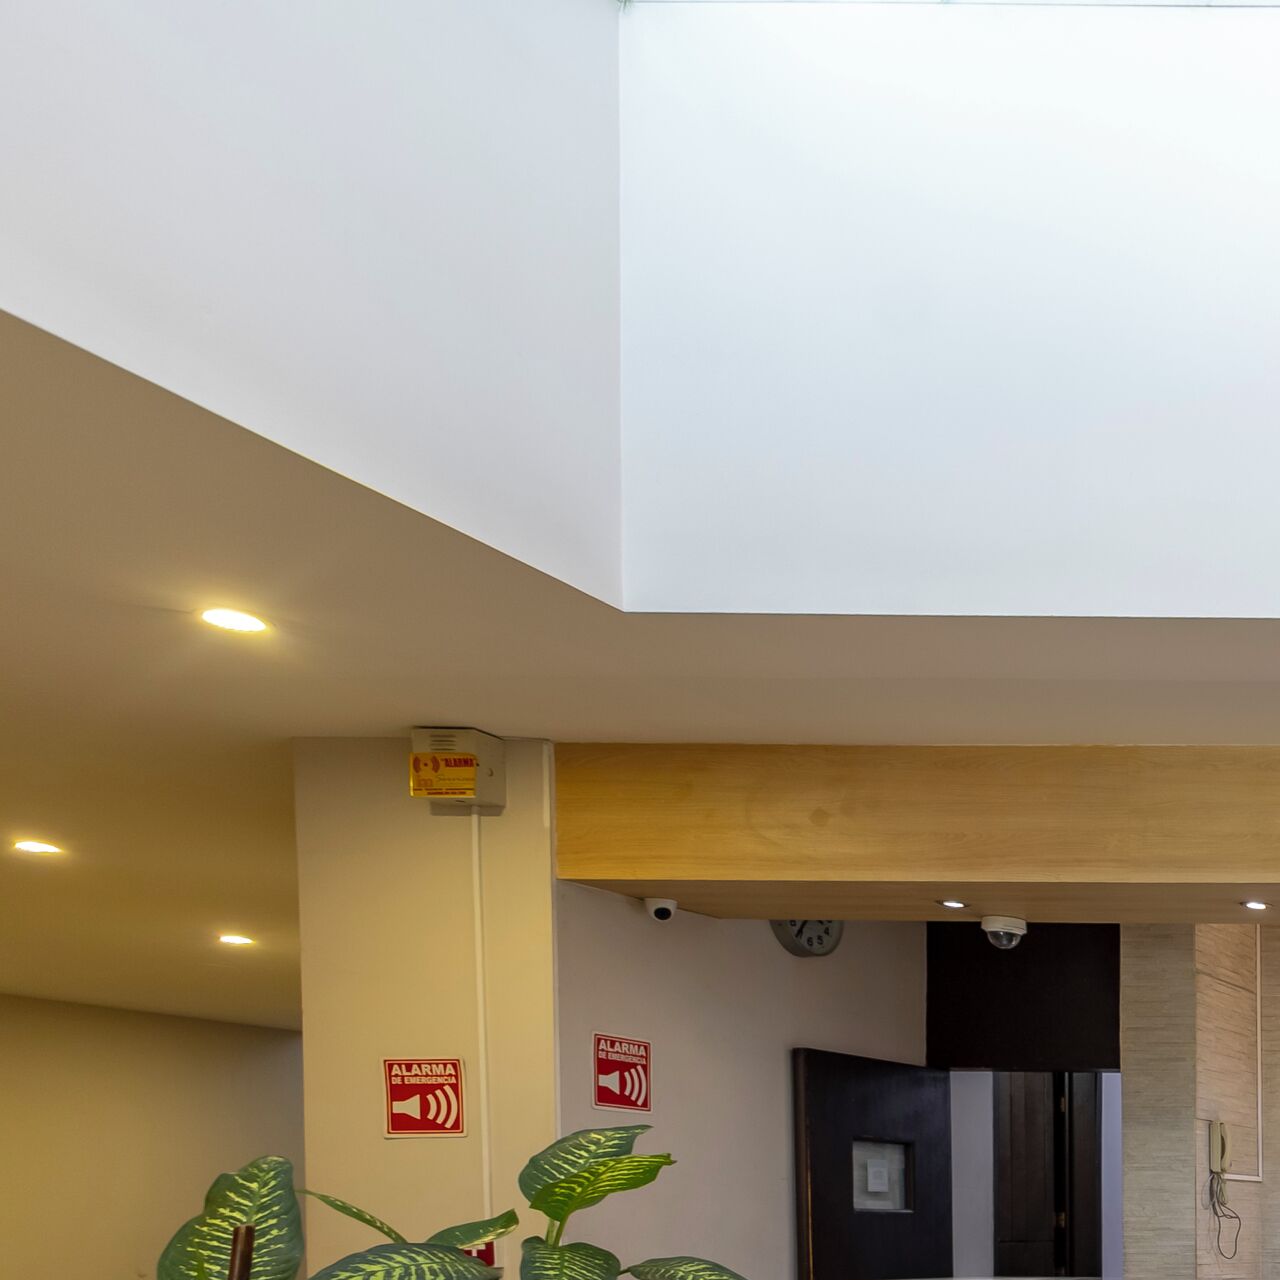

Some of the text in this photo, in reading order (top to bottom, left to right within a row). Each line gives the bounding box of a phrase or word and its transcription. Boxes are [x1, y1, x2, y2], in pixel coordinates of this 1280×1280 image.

[598, 1039, 647, 1057] ALARMA
[598, 1051, 607, 1060] DE
[391, 1063, 456, 1076] ALARMA
[391, 1076, 457, 1085] DE EMERGENCIA
